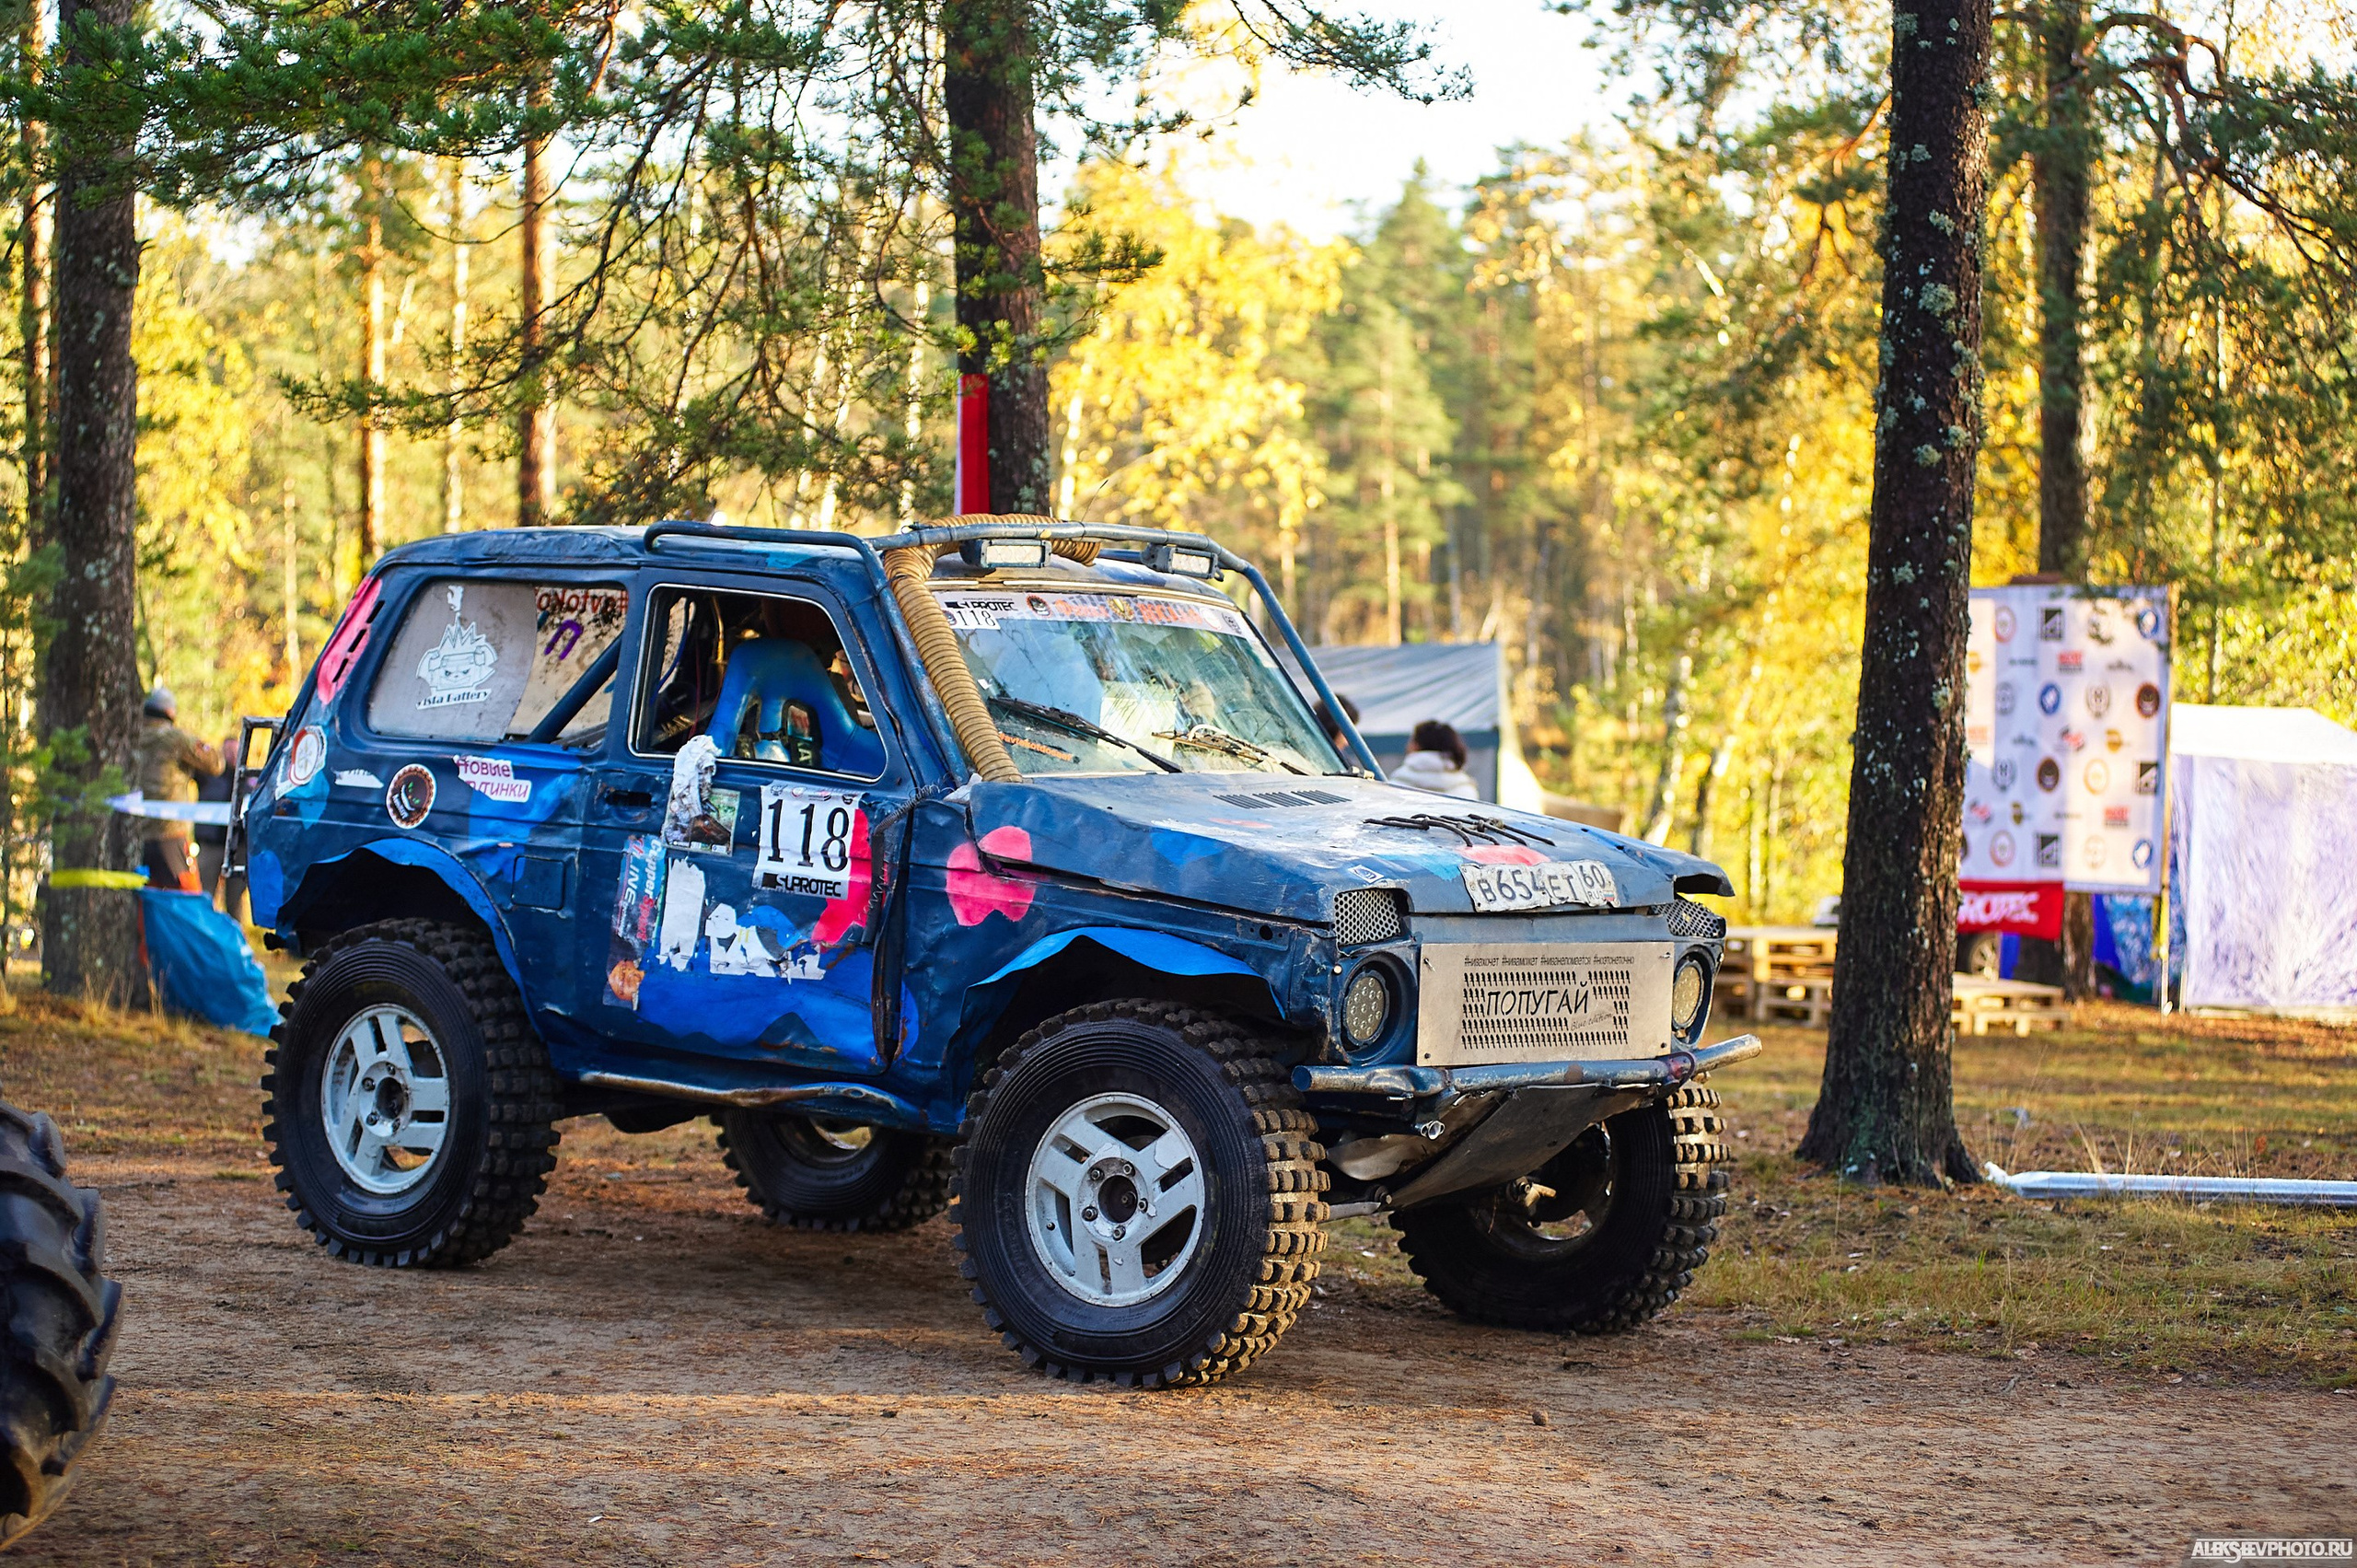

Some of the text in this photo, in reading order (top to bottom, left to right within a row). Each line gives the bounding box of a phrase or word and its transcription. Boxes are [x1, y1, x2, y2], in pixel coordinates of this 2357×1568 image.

[957, 609, 995, 627] 118
[767, 798, 849, 872] 118
[769, 873, 842, 897] SUPROTEC
[1580, 864, 1606, 889] 60
[1486, 981, 1589, 1016] ПОПУГАЙ
